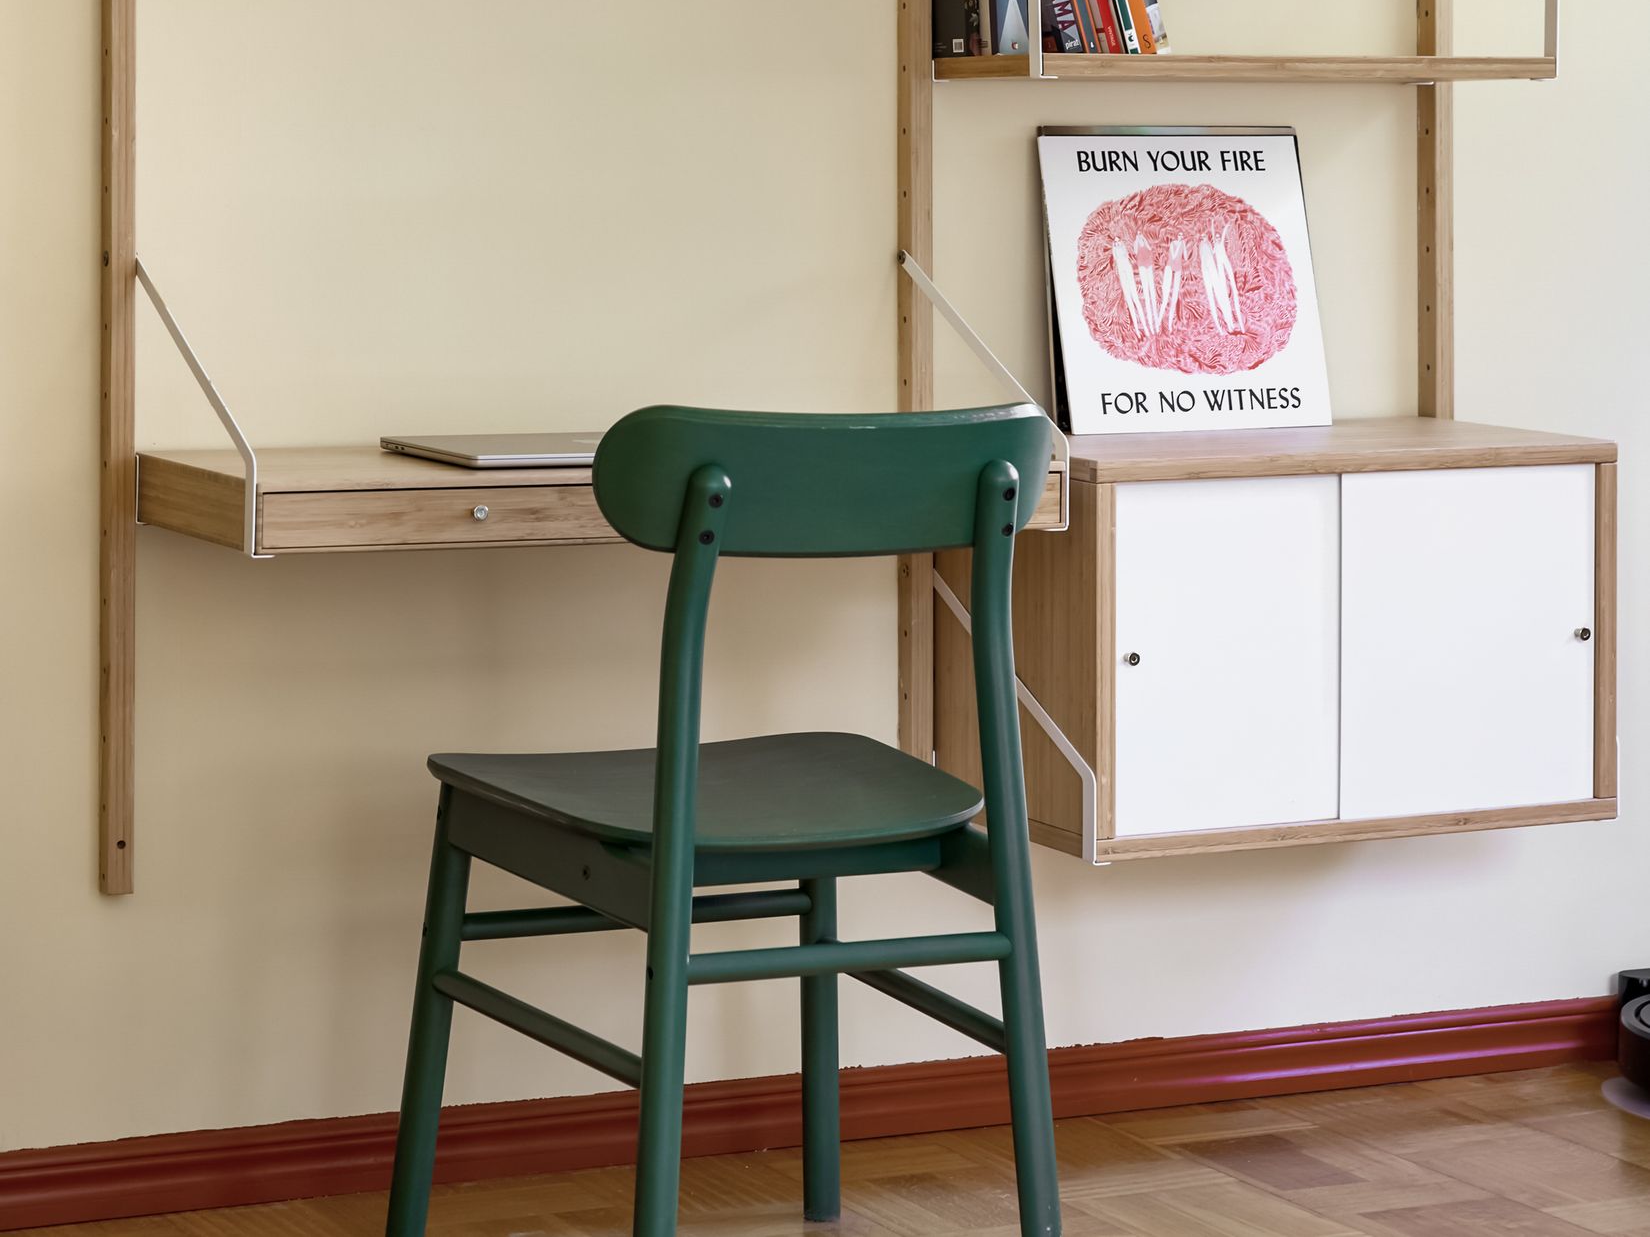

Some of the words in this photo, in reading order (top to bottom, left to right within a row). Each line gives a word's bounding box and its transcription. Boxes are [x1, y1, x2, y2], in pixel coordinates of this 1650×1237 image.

[1064, 35, 1081, 50] pirat
[1106, 26, 1116, 48] VINTAGE
[1076, 150, 1140, 172] BURN
[1146, 150, 1212, 172] YOUR
[1220, 150, 1266, 172] FIRE
[1101, 392, 1149, 414] FOR
[1158, 390, 1196, 413] NO
[1203, 387, 1302, 410] WITNESS
